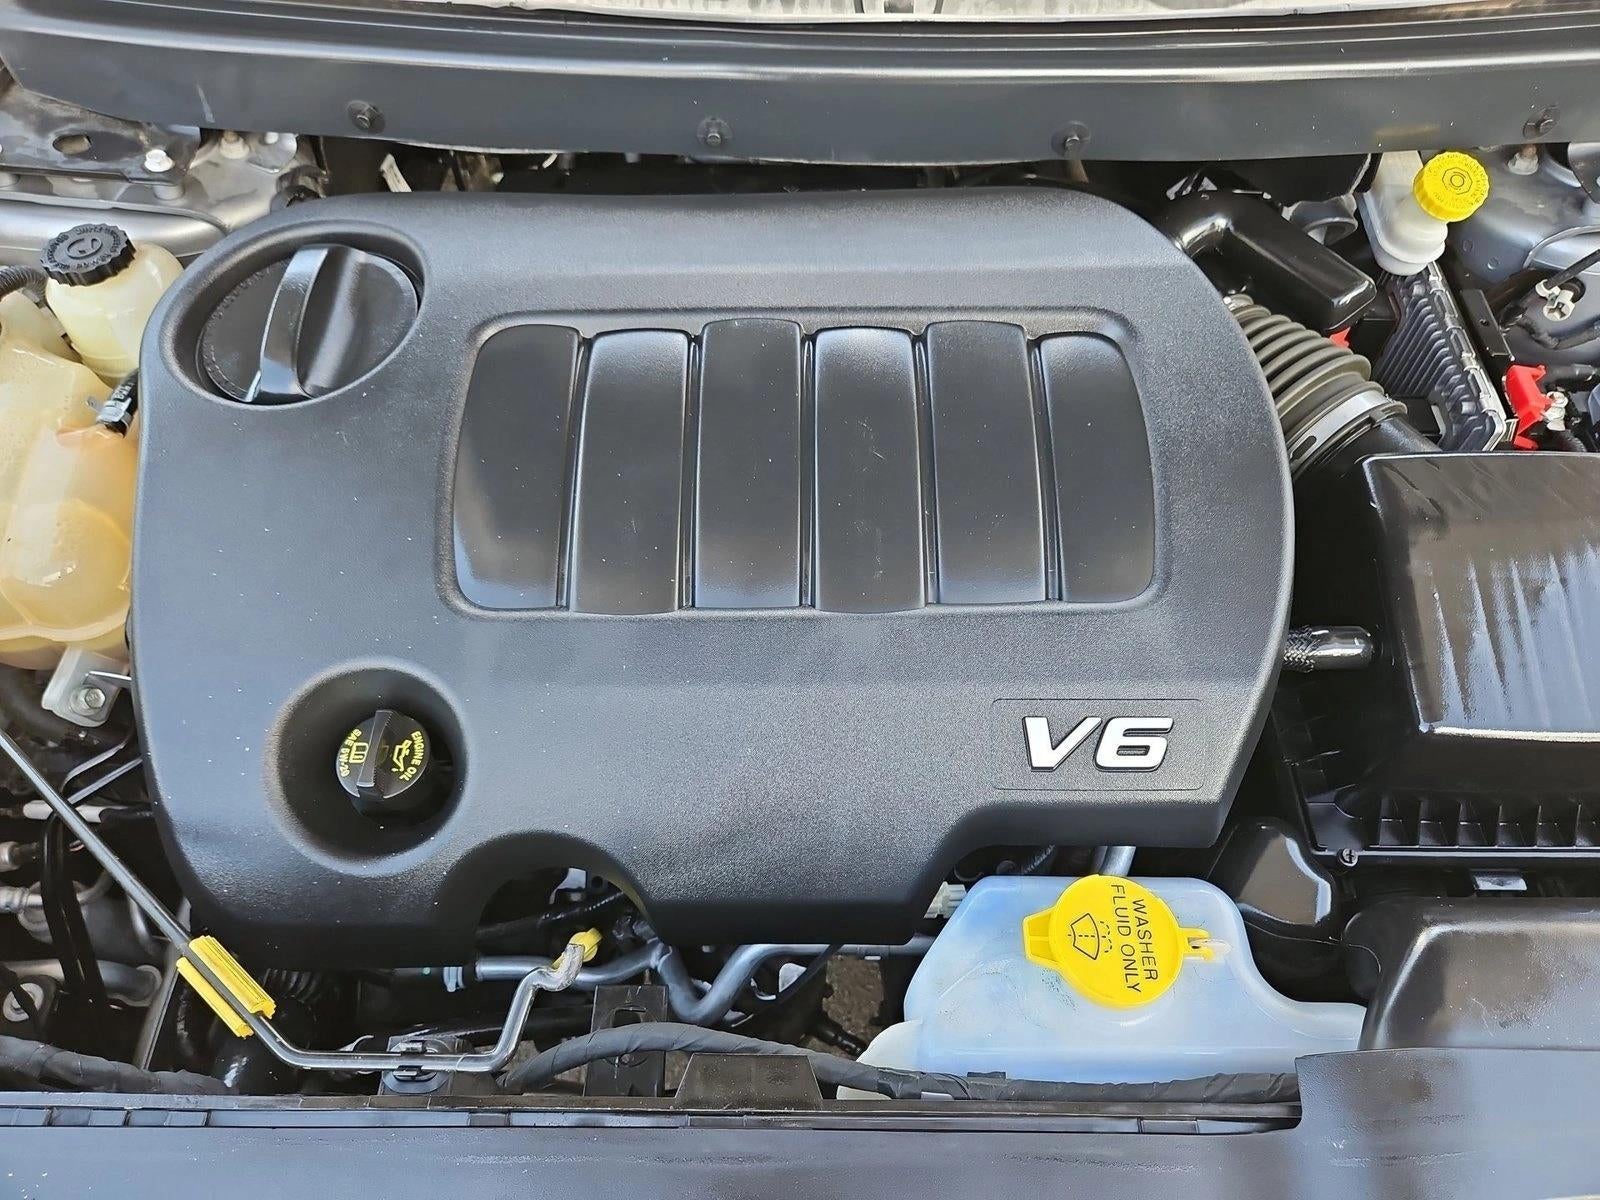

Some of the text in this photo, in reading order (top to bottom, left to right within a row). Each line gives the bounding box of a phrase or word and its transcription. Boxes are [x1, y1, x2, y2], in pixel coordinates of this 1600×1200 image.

[344, 728, 362, 747] SAE
[399, 731, 425, 781] ENGINE OIL
[1022, 716, 1174, 772] V6
[1110, 884, 1142, 993] FLUID ONLY
[1132, 898, 1158, 980] WASHER
